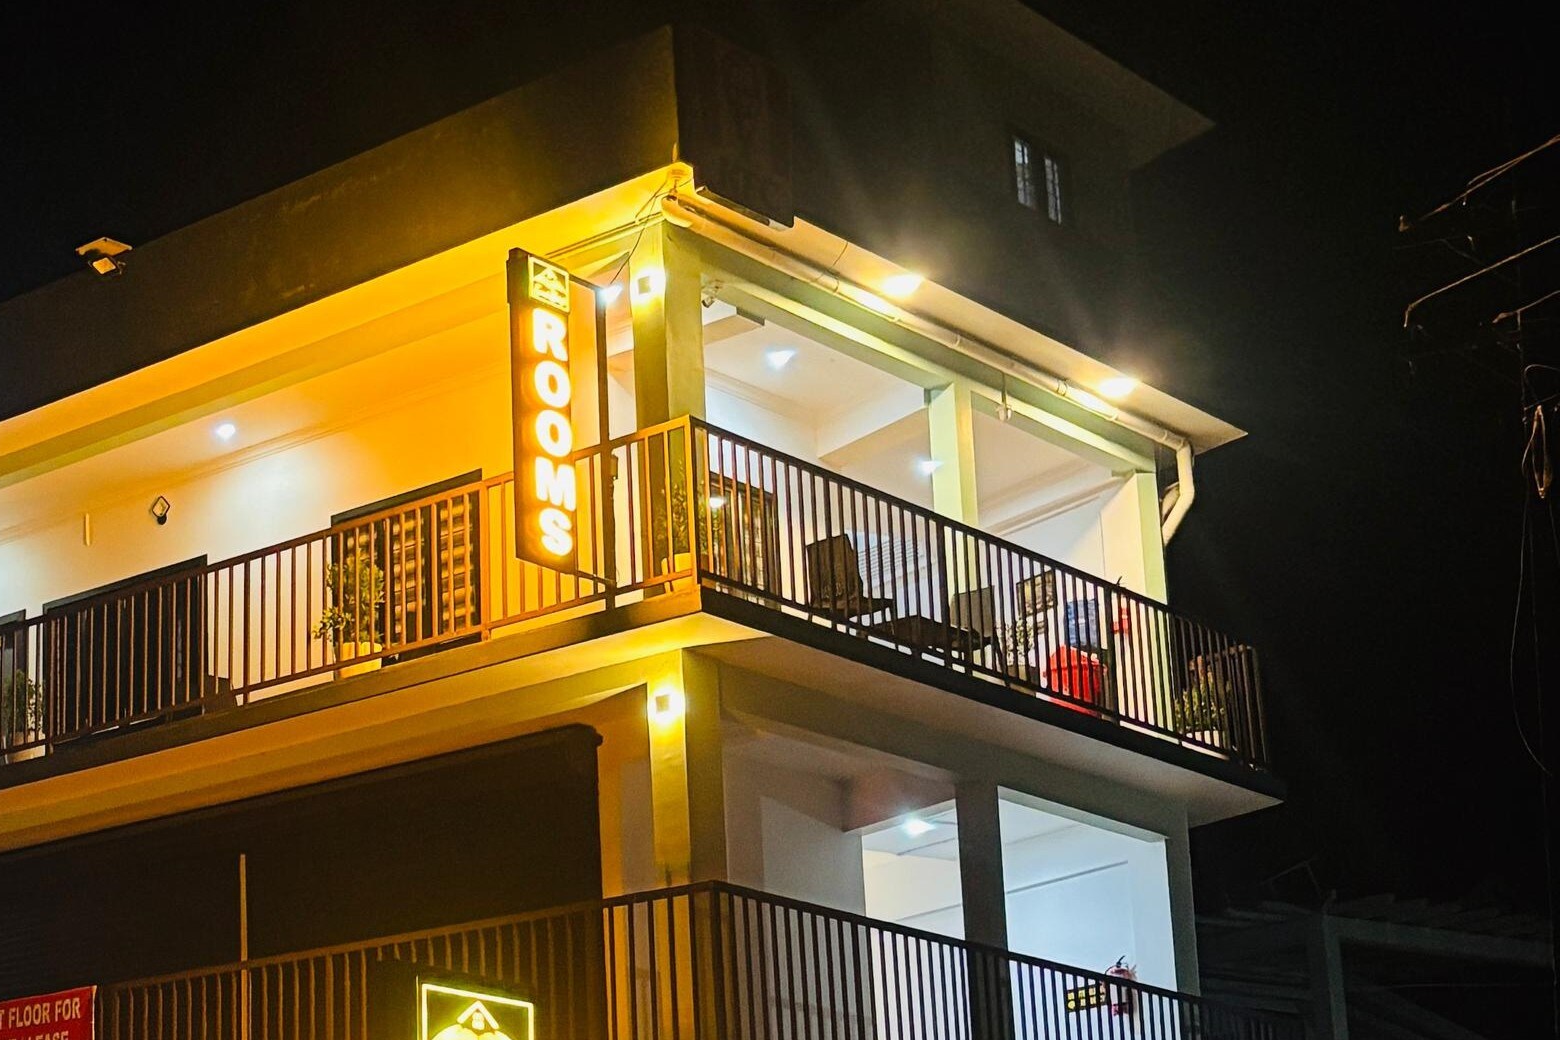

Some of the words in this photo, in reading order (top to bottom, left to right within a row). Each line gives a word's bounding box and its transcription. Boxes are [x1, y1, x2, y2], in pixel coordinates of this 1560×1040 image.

[532, 307, 577, 557] ROOMS
[8, 1002, 50, 1029] FLOOR
[55, 997, 81, 1022] FOR
